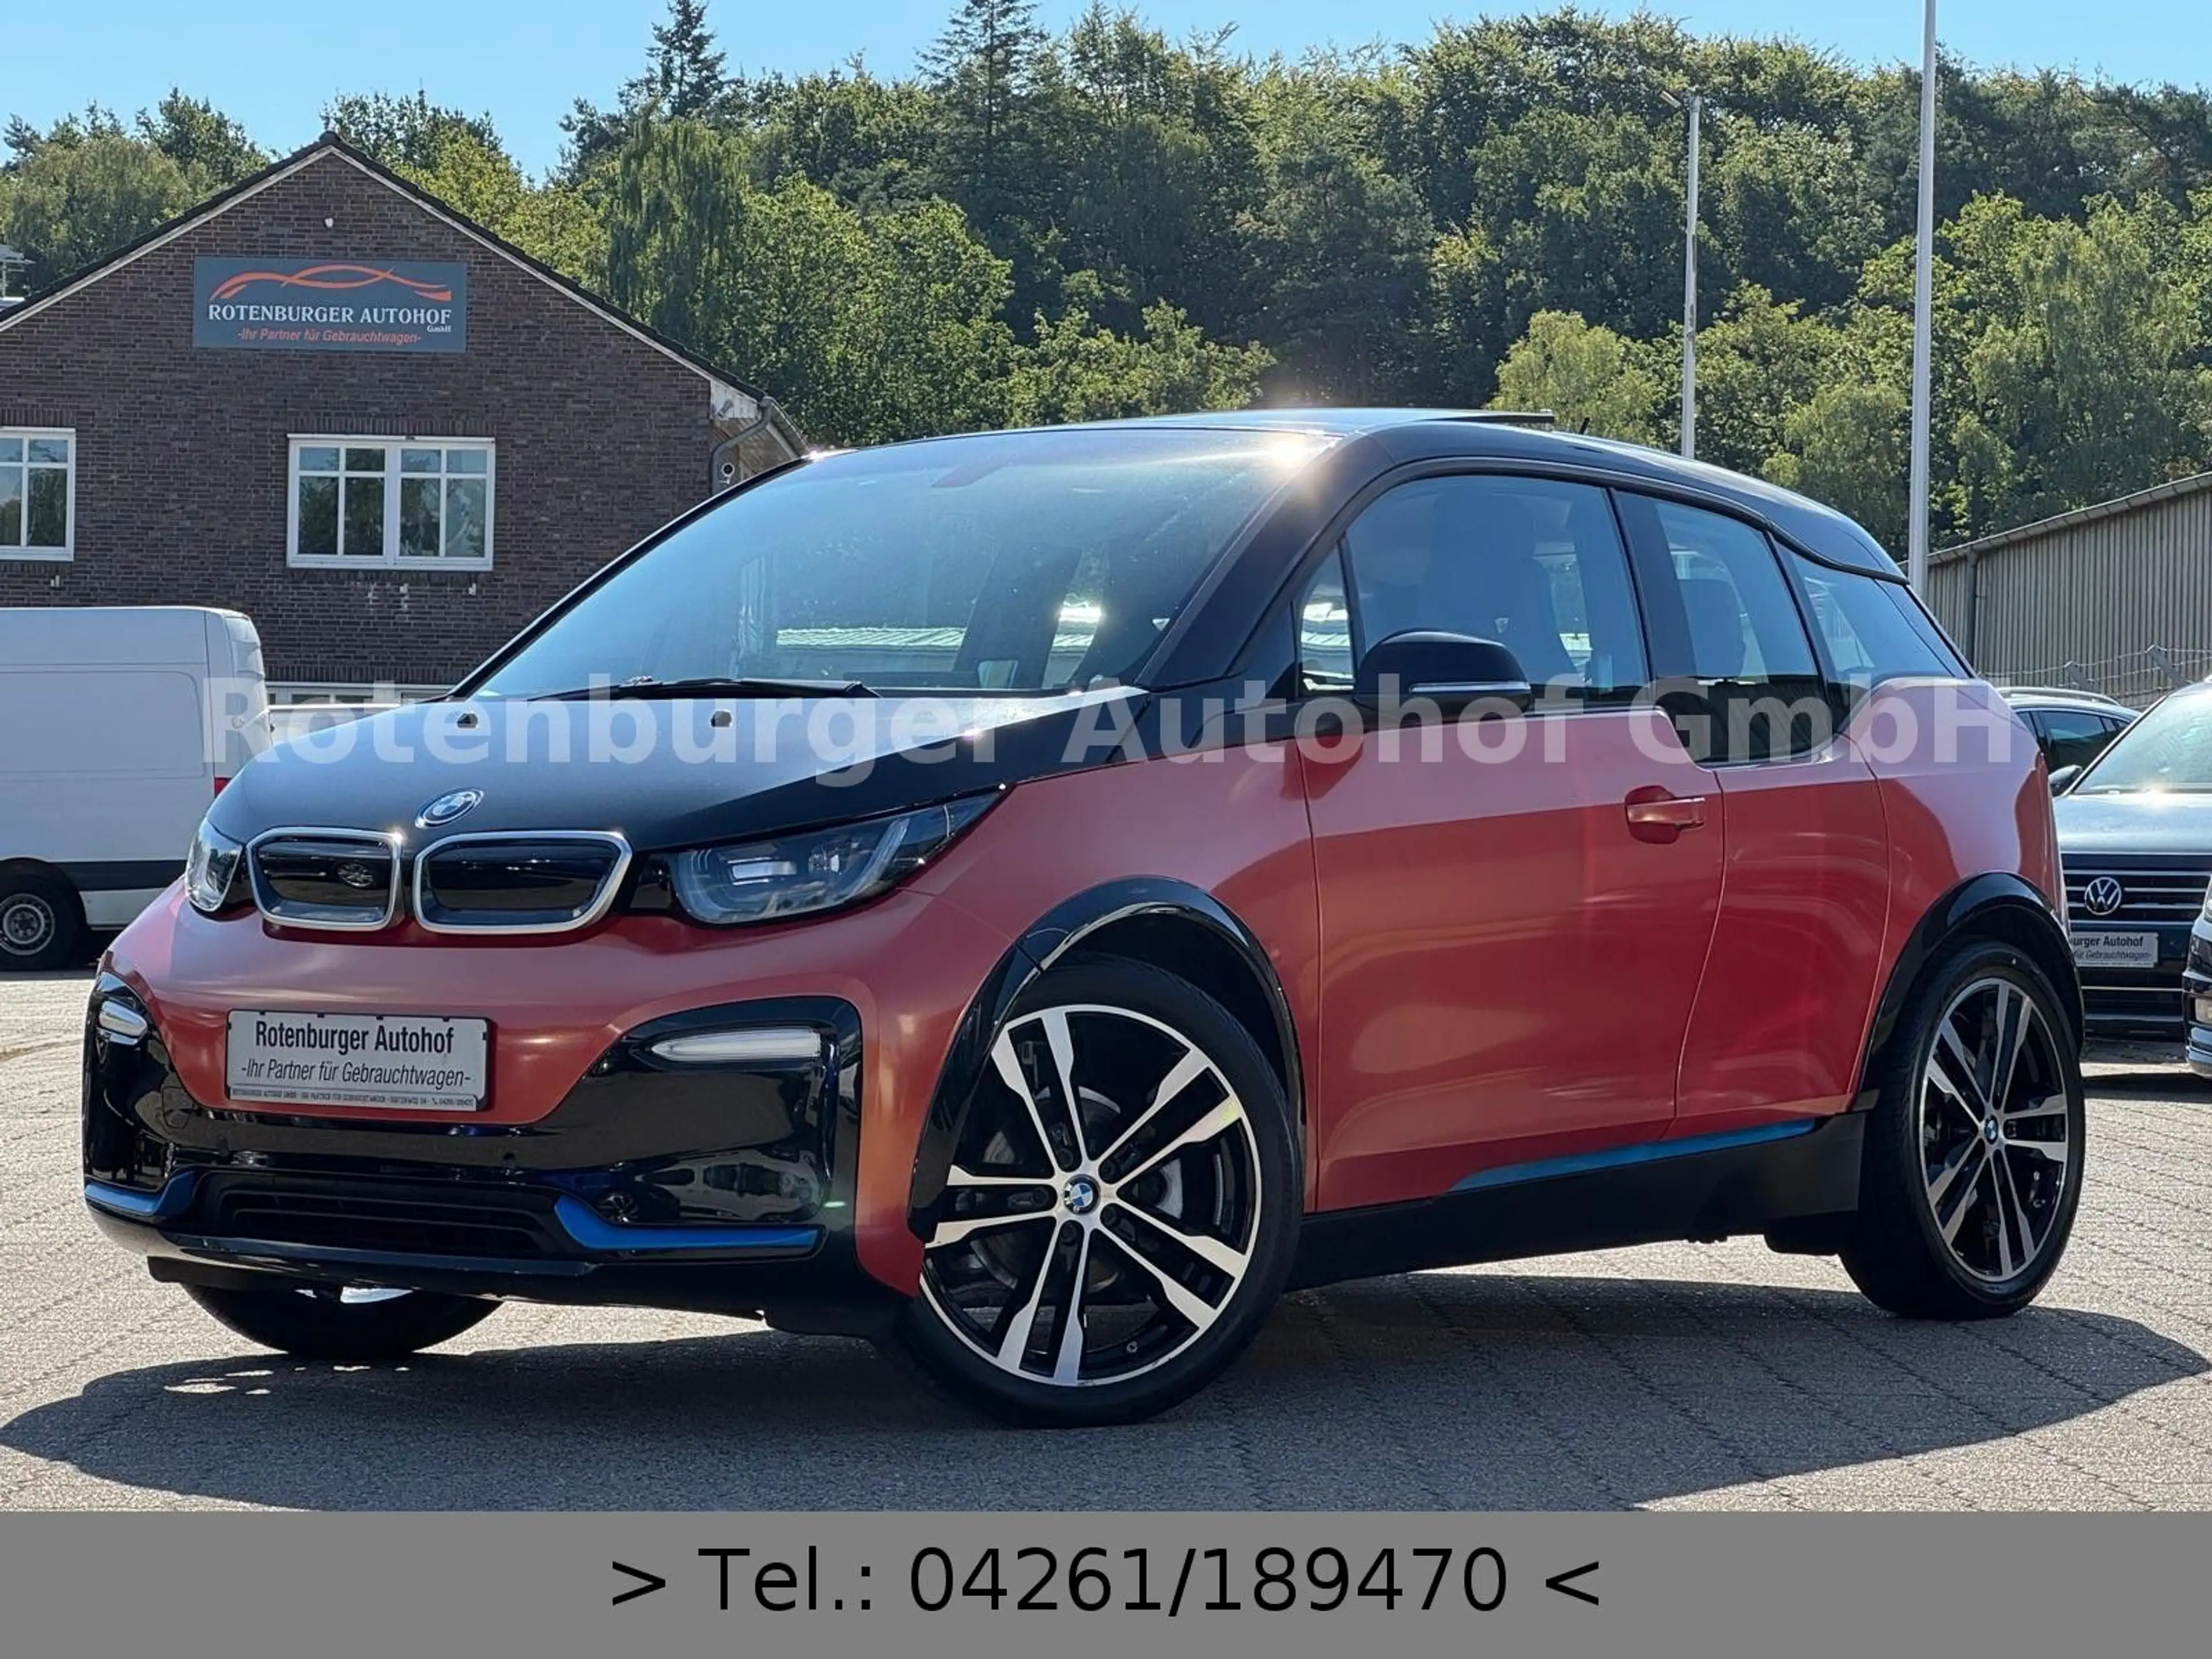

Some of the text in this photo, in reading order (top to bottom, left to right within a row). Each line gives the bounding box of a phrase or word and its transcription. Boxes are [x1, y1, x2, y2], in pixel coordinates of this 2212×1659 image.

[208, 304, 452, 324] ROTENBURGER AUTOHOF
[237, 327, 421, 345] -Ihr Partner für Gebrauchtwagen-
[426, 325, 452, 333] GmbH
[2104, 935, 2144, 947] Autohof
[255, 1021, 454, 1055] Rotenburger Autohof
[241, 1059, 471, 1090] -Ihr Partner für Gebrauchtwagen-
